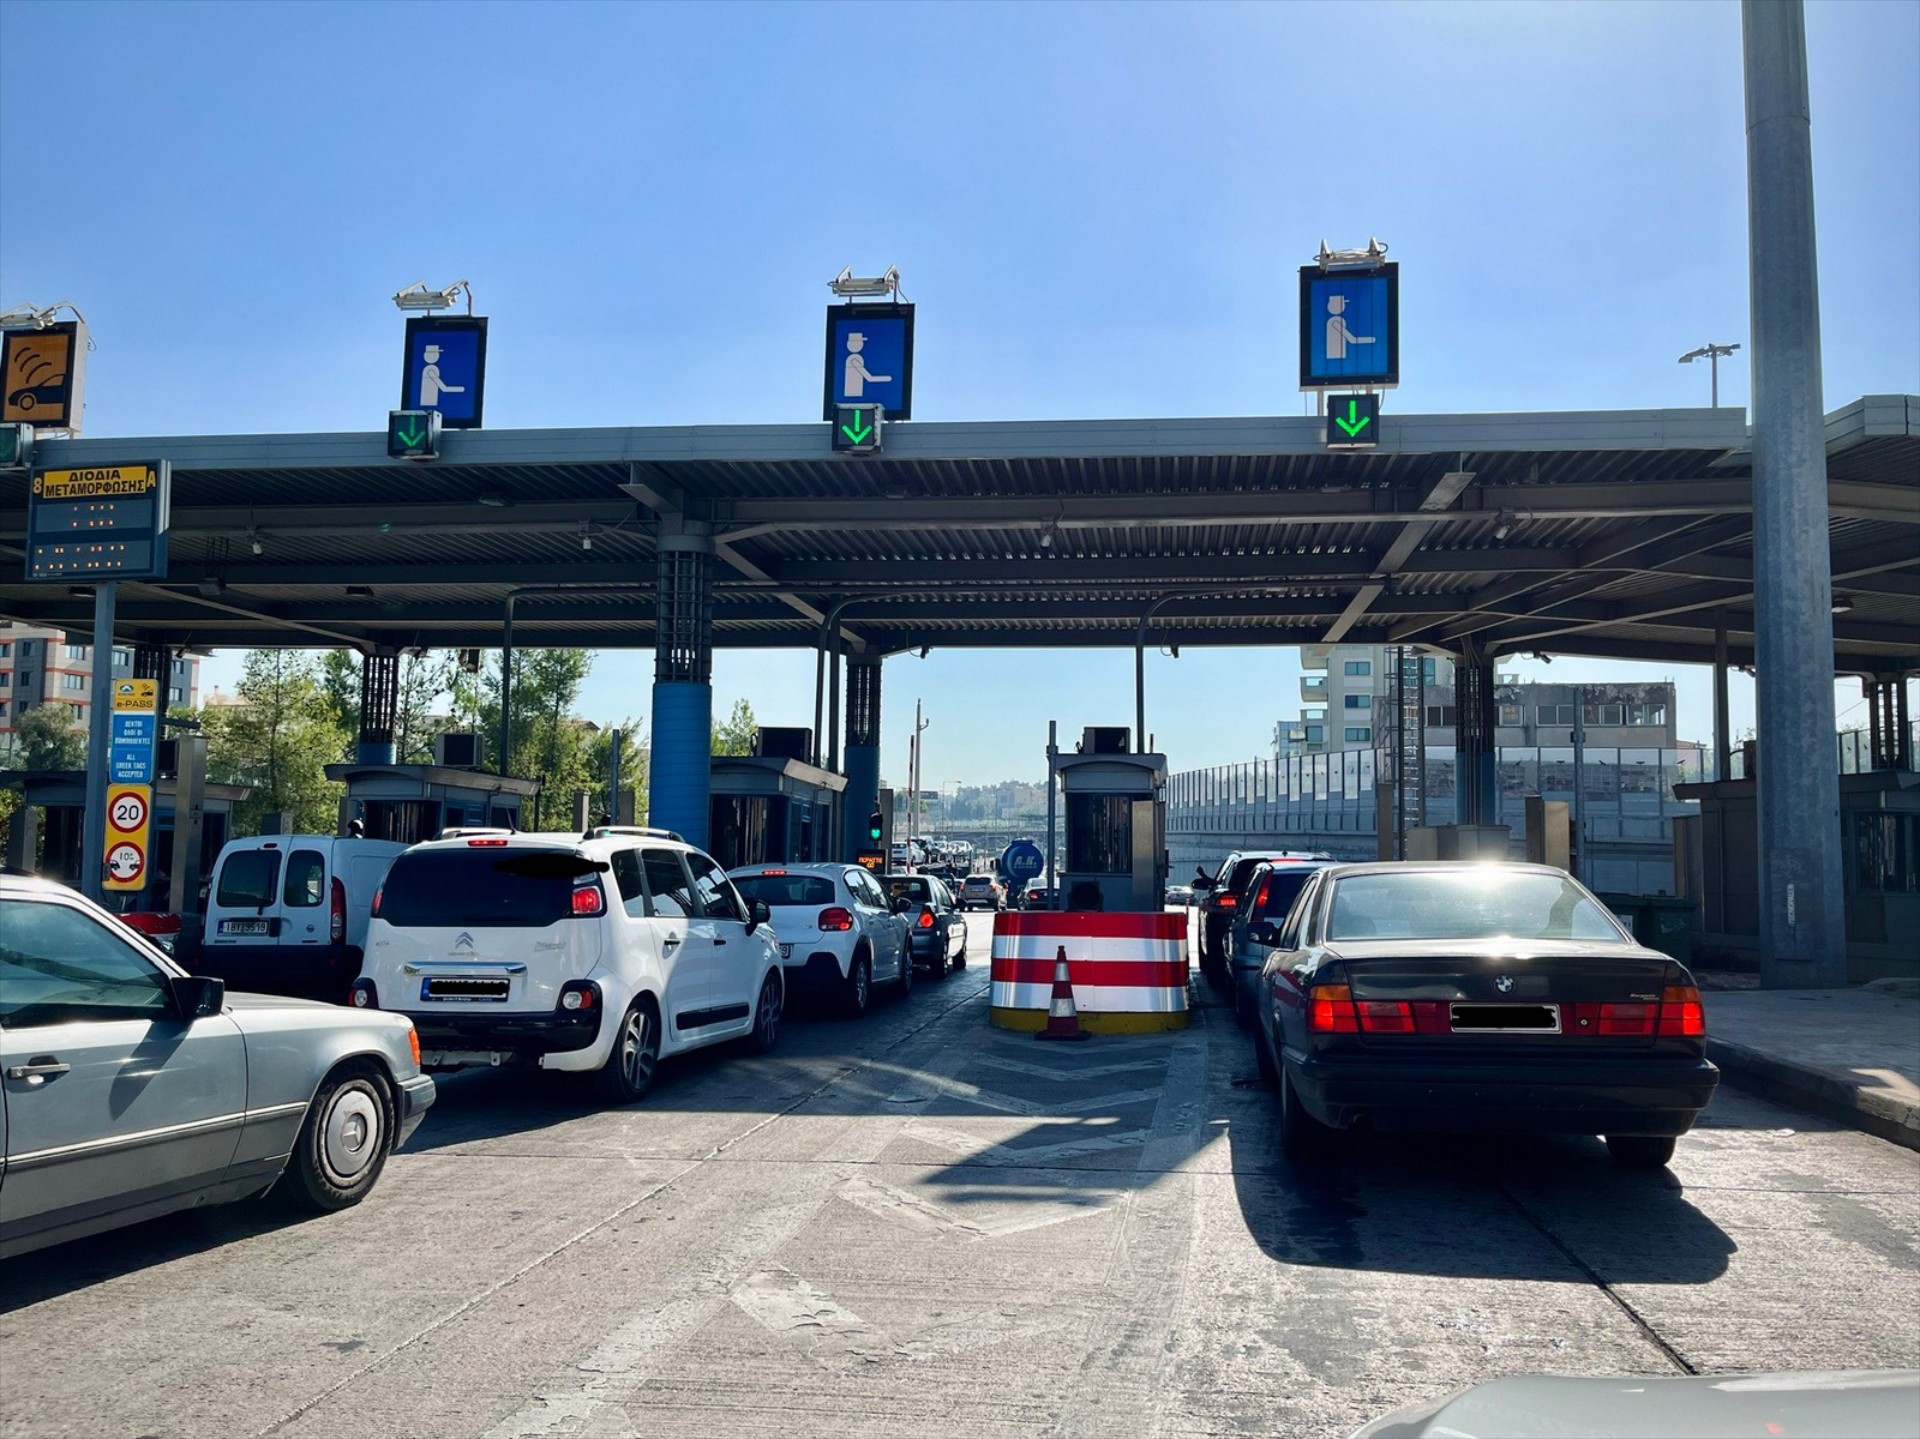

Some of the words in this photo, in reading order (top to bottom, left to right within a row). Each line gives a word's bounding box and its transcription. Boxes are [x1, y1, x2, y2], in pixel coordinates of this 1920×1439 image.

[68, 469, 121, 482] ΔΙΟΔΙΑ
[45, 480, 145, 497] ΜΕΤΑΜΟΡΦΩΣΗΣ
[116, 700, 153, 708] e-PASS
[117, 770, 143, 778] ACCEPTED
[117, 805, 139, 820] 20
